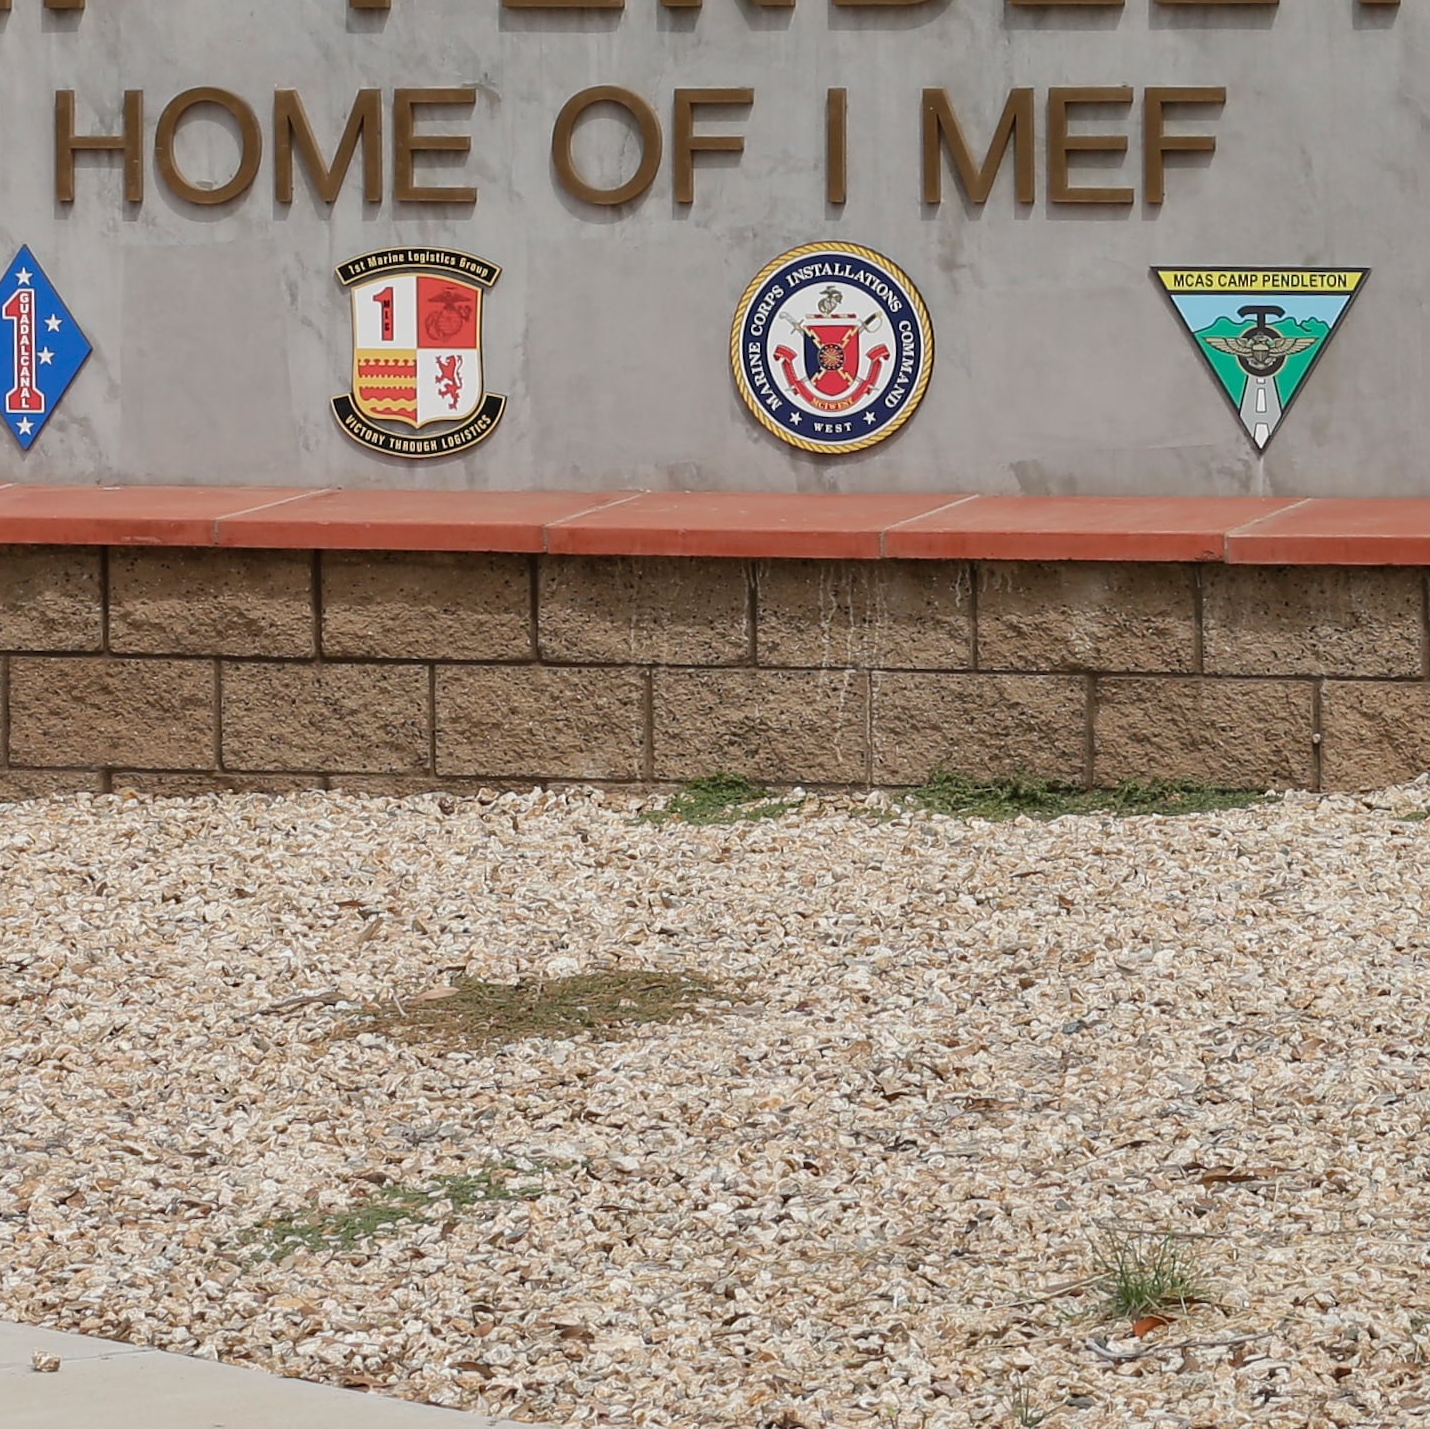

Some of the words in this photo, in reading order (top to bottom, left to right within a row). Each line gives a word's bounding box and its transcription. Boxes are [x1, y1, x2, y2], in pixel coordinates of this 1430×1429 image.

[55, 86, 476, 205] HOME
[552, 85, 755, 205] OF
[827, 88, 846, 203] I
[922, 87, 1226, 203] MEF
[348, 261, 365, 275] 1st
[368, 254, 404, 268] Marine
[408, 251, 456, 265] Logistics
[459, 259, 488, 277] Group
[786, 263, 902, 312] INSTALLATIONS
[1173, 274, 1213, 287] MCAS
[1218, 274, 1258, 287] CAMP
[1263, 274, 1347, 288] PENDLETON
[373, 287, 393, 341] 1
[751, 286, 785, 336] CORPS
[2, 289, 44, 413] 1
[20, 293, 30, 408] GUADALCANAL
[749, 342, 782, 411] MARINE
[884, 320, 915, 408] COMMAND
[345, 414, 385, 445] VICTORY
[390, 438, 437, 451] THROUGH
[441, 414, 491, 449] LOGISTICS
[814, 423, 852, 433] WEST
